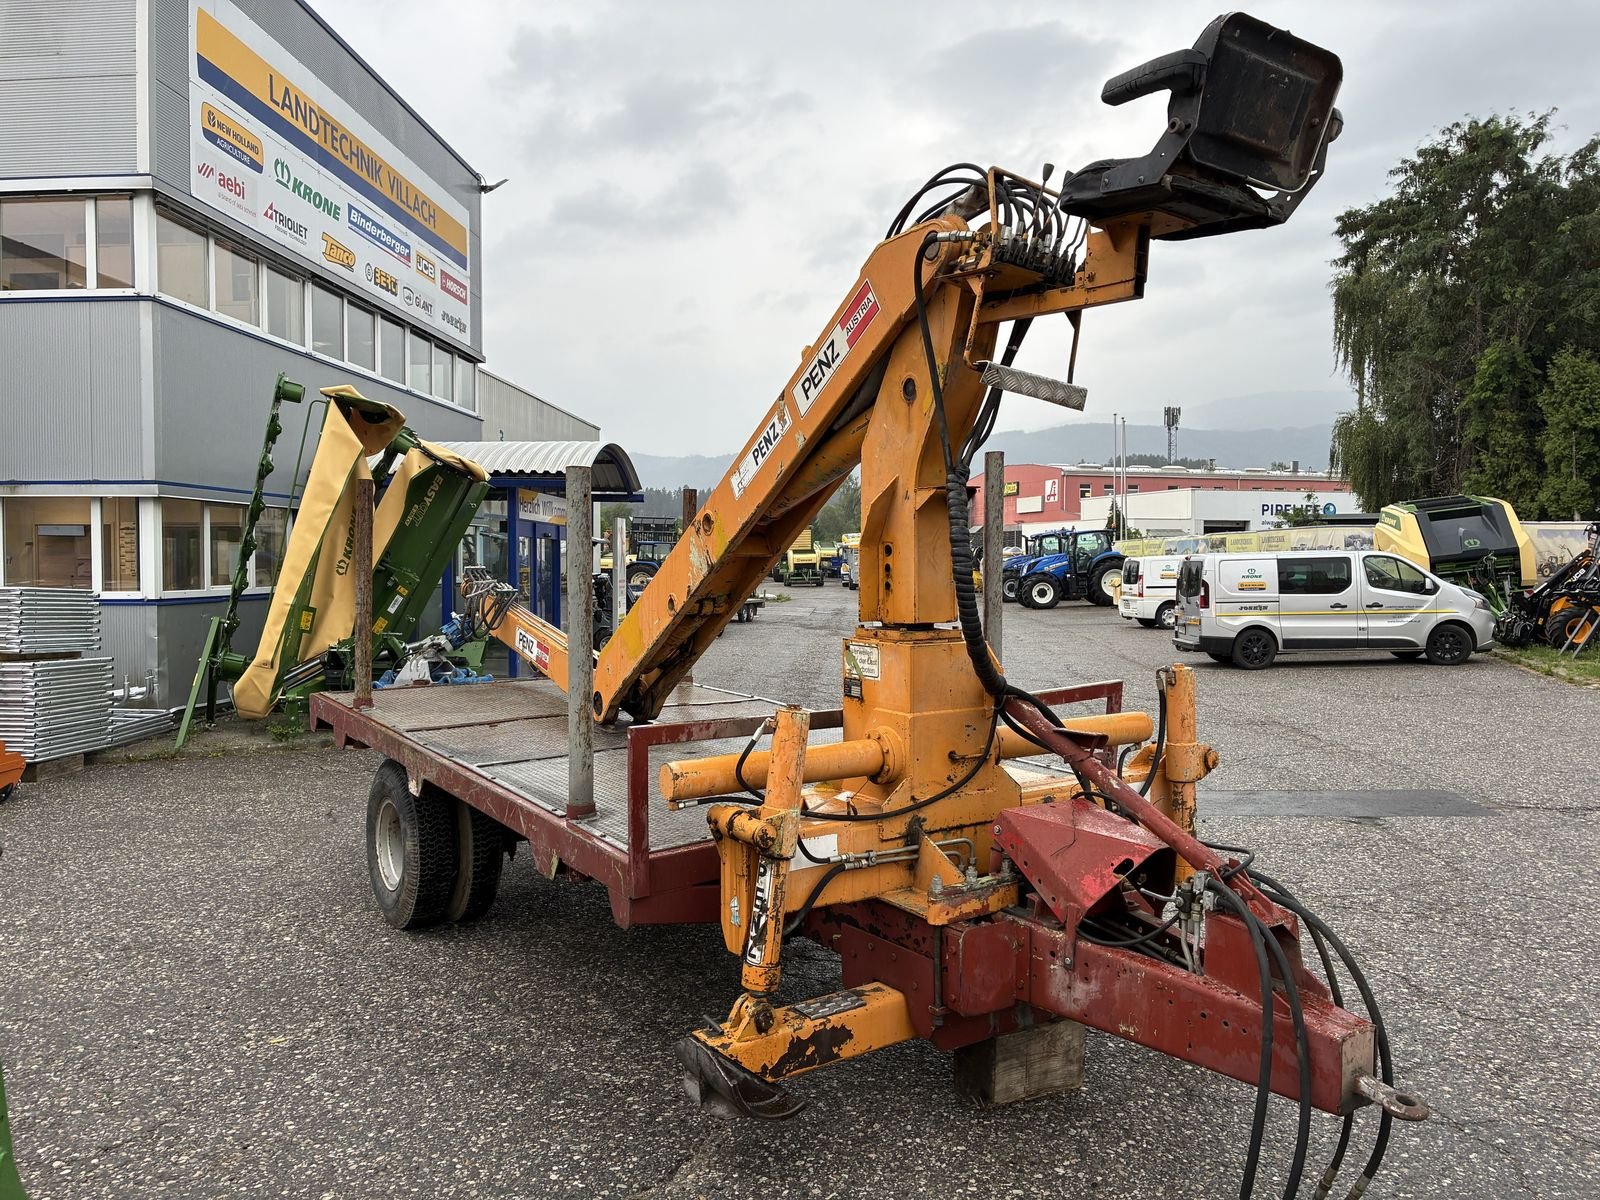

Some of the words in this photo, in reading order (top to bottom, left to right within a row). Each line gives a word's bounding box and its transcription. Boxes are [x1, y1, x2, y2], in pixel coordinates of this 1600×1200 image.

[216, 119, 232, 137] NEW
[232, 128, 259, 155] HOLLAND
[216, 138, 251, 165] AGRICULTURE
[268, 73, 383, 188] LANDTECHNIK
[387, 174, 436, 229] VILLACH
[218, 172, 245, 200] aebi
[291, 177, 341, 222] KRONE
[273, 209, 308, 240] TRIOLIET
[350, 208, 409, 257] Binderberger
[322, 231, 356, 267] Tanco
[417, 255, 435, 279] JCB
[446, 278, 466, 300] HORSCH
[800, 338, 840, 401] PENZ
[845, 296, 872, 337] AUSTRIA
[752, 421, 779, 467] PENZ
[519, 496, 541, 514] Herzlich
[1571, 568, 1586, 582] JCB
[518, 631, 534, 655] PENZ
